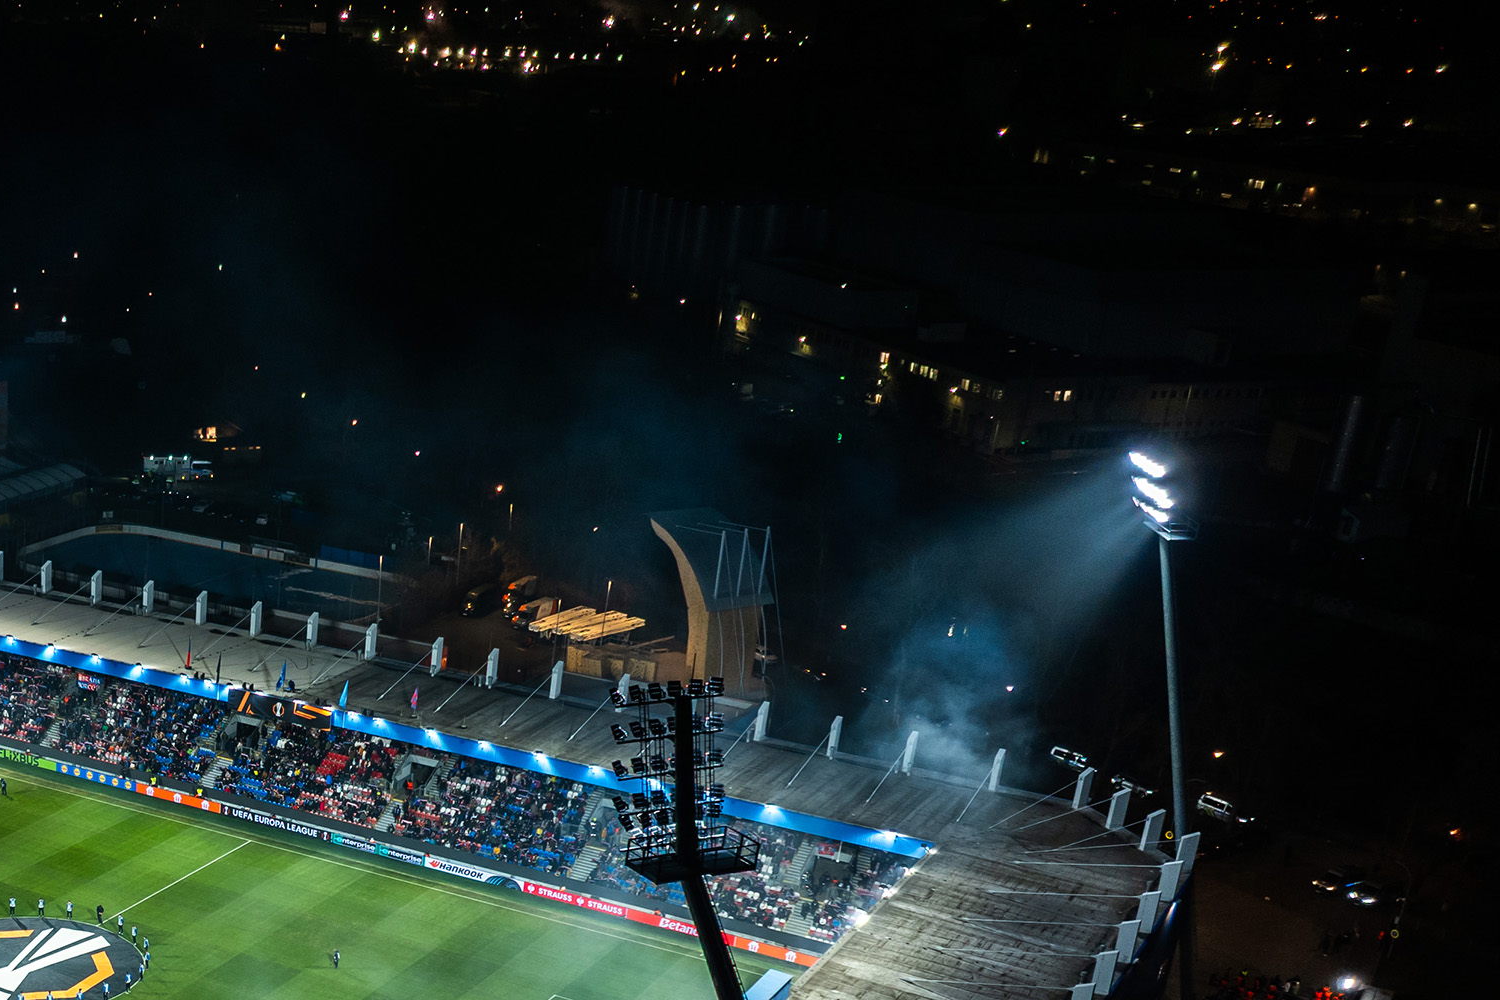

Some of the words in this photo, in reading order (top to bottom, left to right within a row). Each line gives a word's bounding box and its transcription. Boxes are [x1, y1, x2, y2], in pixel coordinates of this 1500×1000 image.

[232, 808, 253, 821] UEFA
[254, 814, 286, 830] EUROPA
[286, 823, 318, 838] LEAGUE
[336, 836, 376, 850] enterprise
[381, 848, 422, 864] enterprise
[538, 887, 573, 902] STRAUSS
[587, 900, 623, 915] STRAUSS
